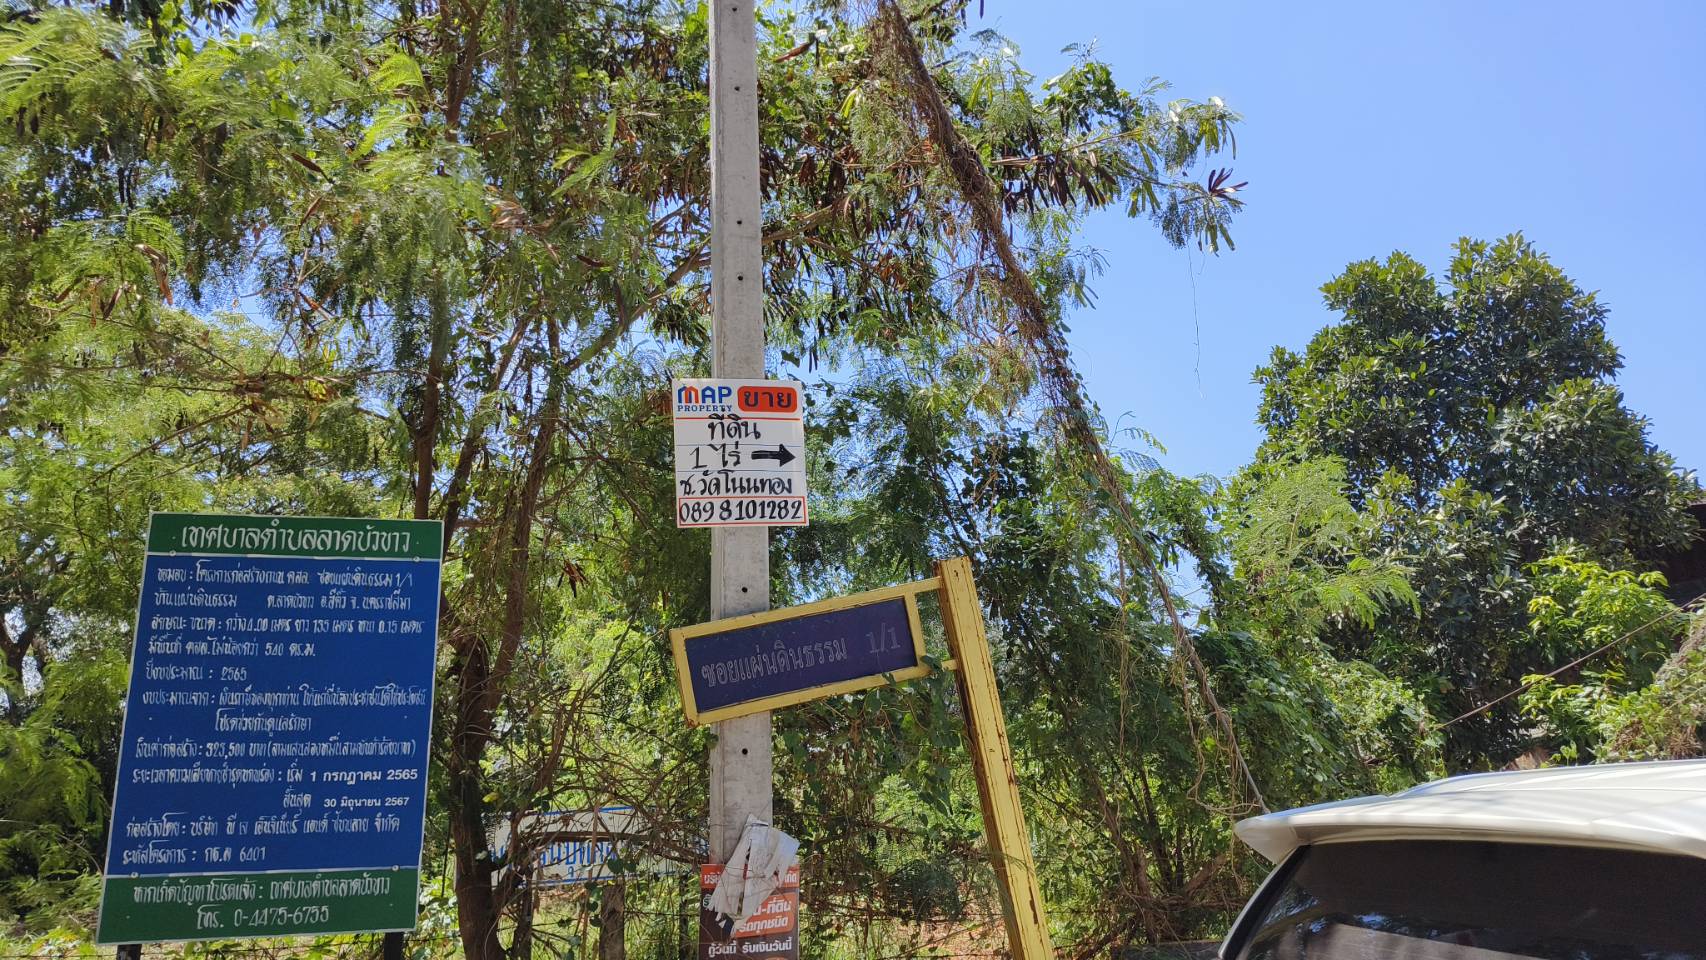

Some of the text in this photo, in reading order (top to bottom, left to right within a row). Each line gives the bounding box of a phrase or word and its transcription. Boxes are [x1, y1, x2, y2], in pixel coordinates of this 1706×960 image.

[678, 384, 732, 404] MAP
[744, 391, 792, 408] ขาย
[678, 404, 732, 412] PROPERTY
[708, 407, 761, 440] ที่ดิน
[690, 441, 741, 469] 1 ไร่
[181, 518, 411, 553] เทศบาลตำบลลาดบัวขาว
[196, 559, 285, 584] โครงการก่อสร้างถนน
[317, 566, 393, 587] ซอยแผ่นดินธรรม
[395, 573, 413, 589] 1/1
[267, 592, 314, 609] ต.ลาดบัวขาว
[151, 614, 187, 630] ลักษณะ
[190, 617, 215, 631] ขนาด
[270, 618, 292, 632] เมตร
[295, 619, 310, 633] ยาว
[332, 619, 355, 633] เมตร
[358, 619, 375, 633] หนา
[379, 620, 398, 634] 0.15
[400, 620, 424, 634] เมตร
[264, 643, 284, 656] 540
[701, 622, 902, 687] ซอยแผ่นดินธรรม 1/1
[145, 658, 203, 680] ปีงบประมาณ
[220, 667, 247, 681] 2565
[214, 707, 311, 737] โปรดช่วยกันดูแลรักษา
[286, 760, 303, 782] เริ่ม
[310, 771, 316, 782] 1
[323, 770, 381, 785] กรกฎาคม
[386, 769, 418, 780] 2565
[283, 785, 410, 814] สิ้นสุด 30 มิถุนายน 2567
[190, 815, 218, 837] บริษัท
[303, 811, 330, 833] แอนด์
[374, 812, 400, 832] จำกัด
[240, 846, 266, 862] 6401
[133, 877, 255, 906] หากเกิดปัญหาโปรดแจ้ง
[270, 876, 390, 898] เทศบาลตำบลลาดบัวขาว
[197, 903, 224, 929] โทร.
[742, 937, 792, 954] รับเงินวันนี้
